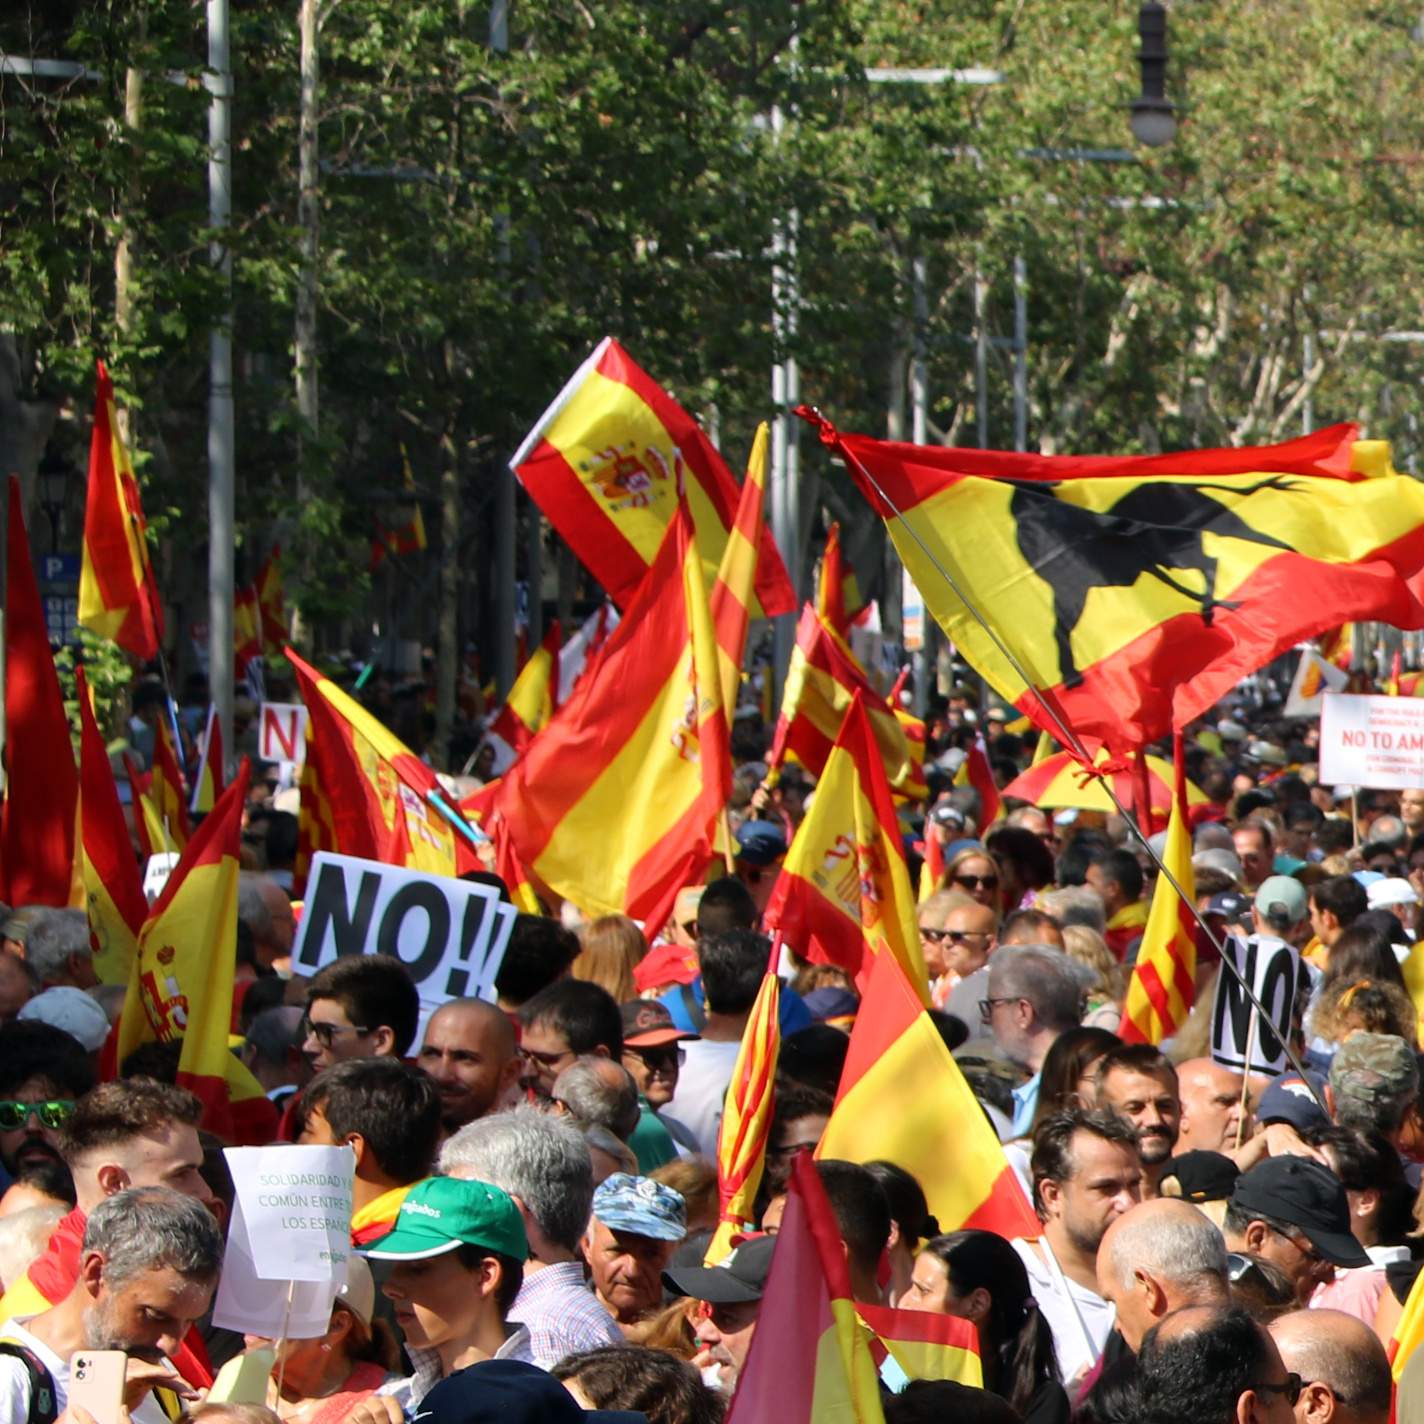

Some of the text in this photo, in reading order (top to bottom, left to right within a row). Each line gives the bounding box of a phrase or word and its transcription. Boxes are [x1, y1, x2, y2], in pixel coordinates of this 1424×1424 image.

[264, 707, 299, 761] N
[1342, 729, 1366, 748] NO
[1371, 731, 1393, 750] TO
[1213, 936, 1295, 1064] NO
[260, 1174, 340, 1188] SOLIDARIDAD
[258, 1193, 308, 1208] COMÚN
[311, 1196, 343, 1210] ENTRE
[281, 1217, 307, 1230] LOS
